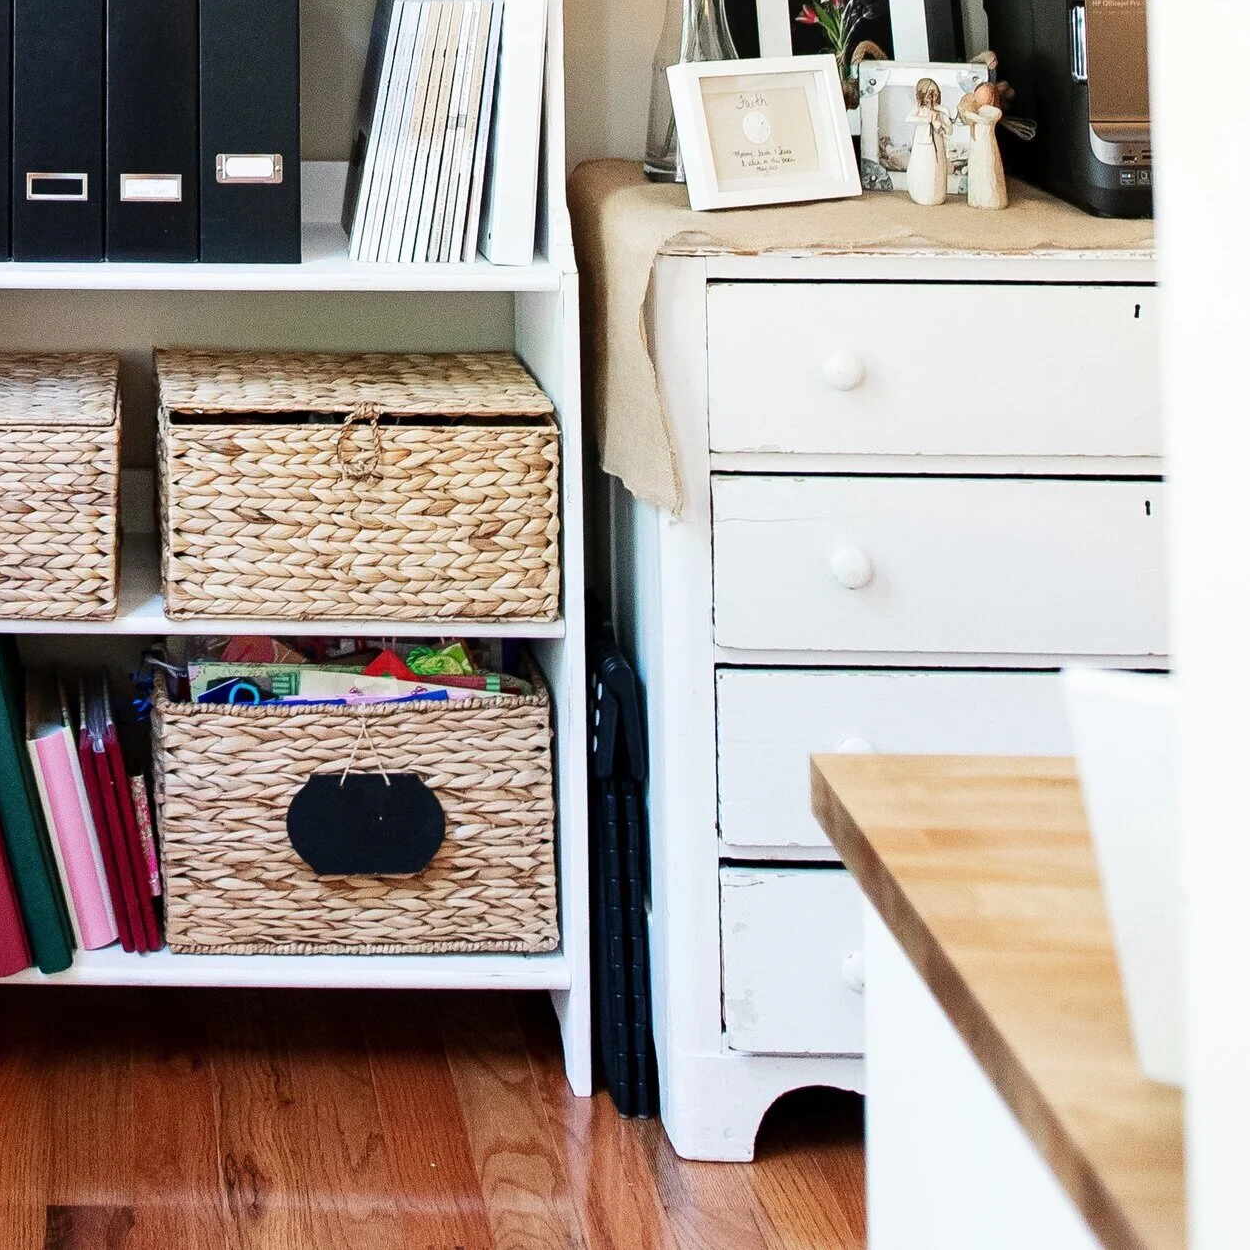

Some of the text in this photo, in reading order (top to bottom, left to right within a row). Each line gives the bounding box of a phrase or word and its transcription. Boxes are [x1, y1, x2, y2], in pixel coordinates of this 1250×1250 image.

[1091, 0, 1102, 7] HP
[1130, 0, 1141, 7] Pro
[734, 92, 768, 110] Faith
